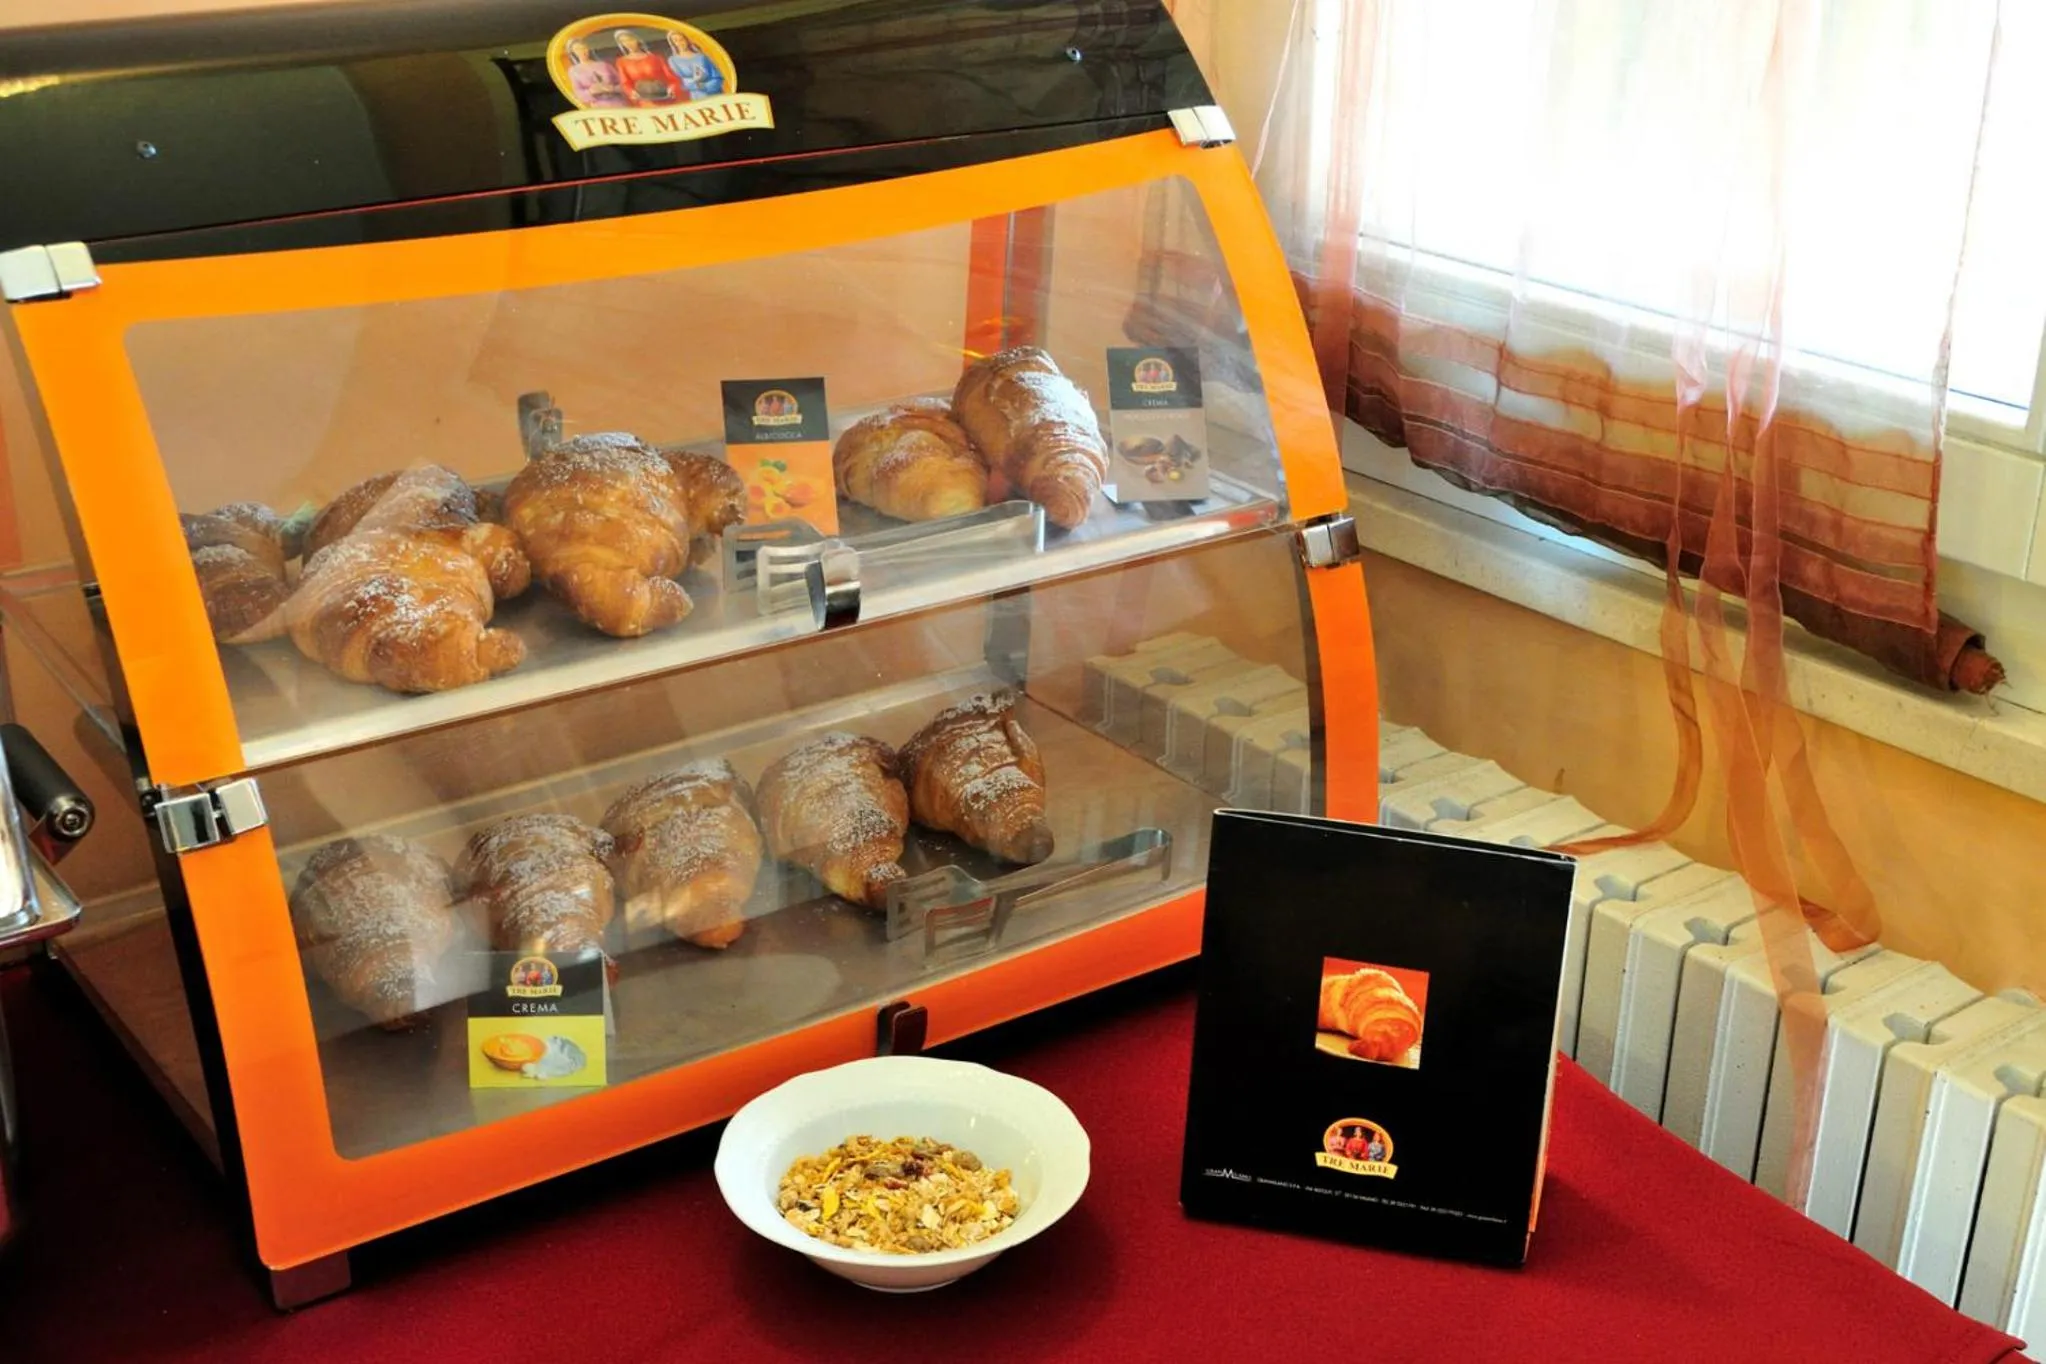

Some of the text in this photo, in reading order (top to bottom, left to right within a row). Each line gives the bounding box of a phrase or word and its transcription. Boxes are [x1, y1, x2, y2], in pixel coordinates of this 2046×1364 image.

[574, 102, 757, 138] TRE MARIE
[511, 1002, 559, 1014] CREMA
[1322, 1155, 1389, 1174] TRE MARIE
